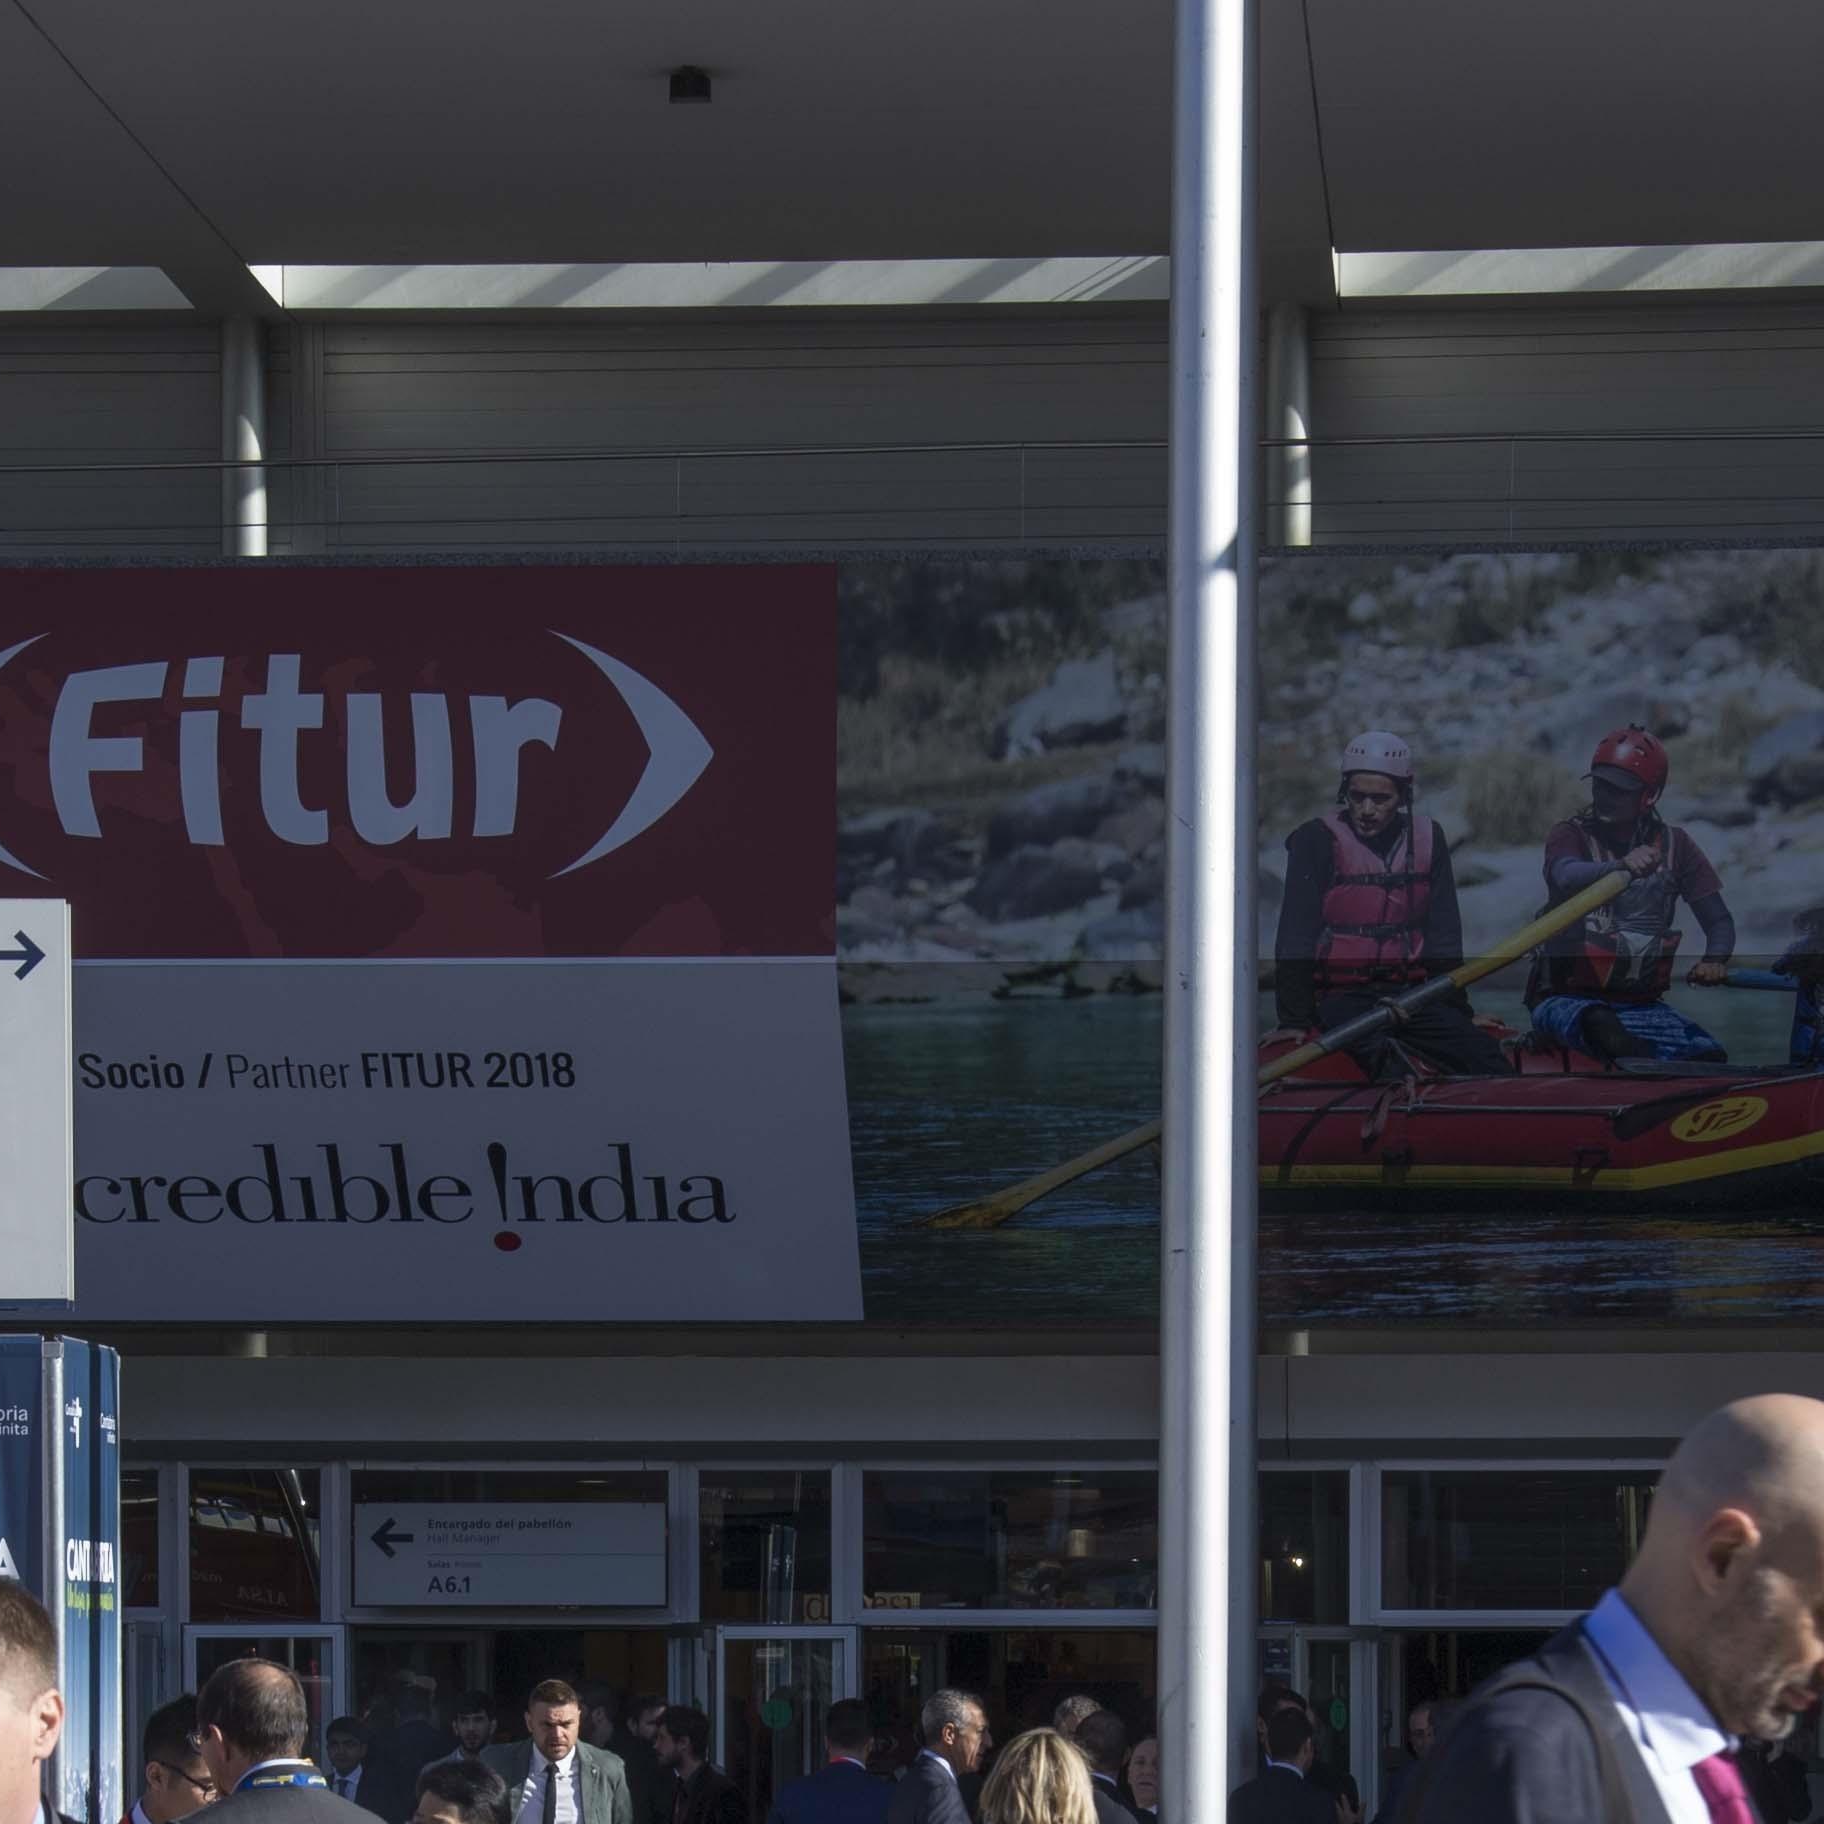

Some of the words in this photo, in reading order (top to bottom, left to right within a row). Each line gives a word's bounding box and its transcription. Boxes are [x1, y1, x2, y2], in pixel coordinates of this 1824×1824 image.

[49, 653, 563, 847] Fitur
[80, 1051, 185, 1093] Socio
[227, 1053, 351, 1091] Partner
[360, 1051, 474, 1090] FITUR
[484, 1050, 574, 1089] 2018
[73, 1142, 474, 1226] credible
[427, 1518, 492, 1531] Encargado
[495, 1518, 514, 1529] del
[518, 1518, 573, 1531] pabellón
